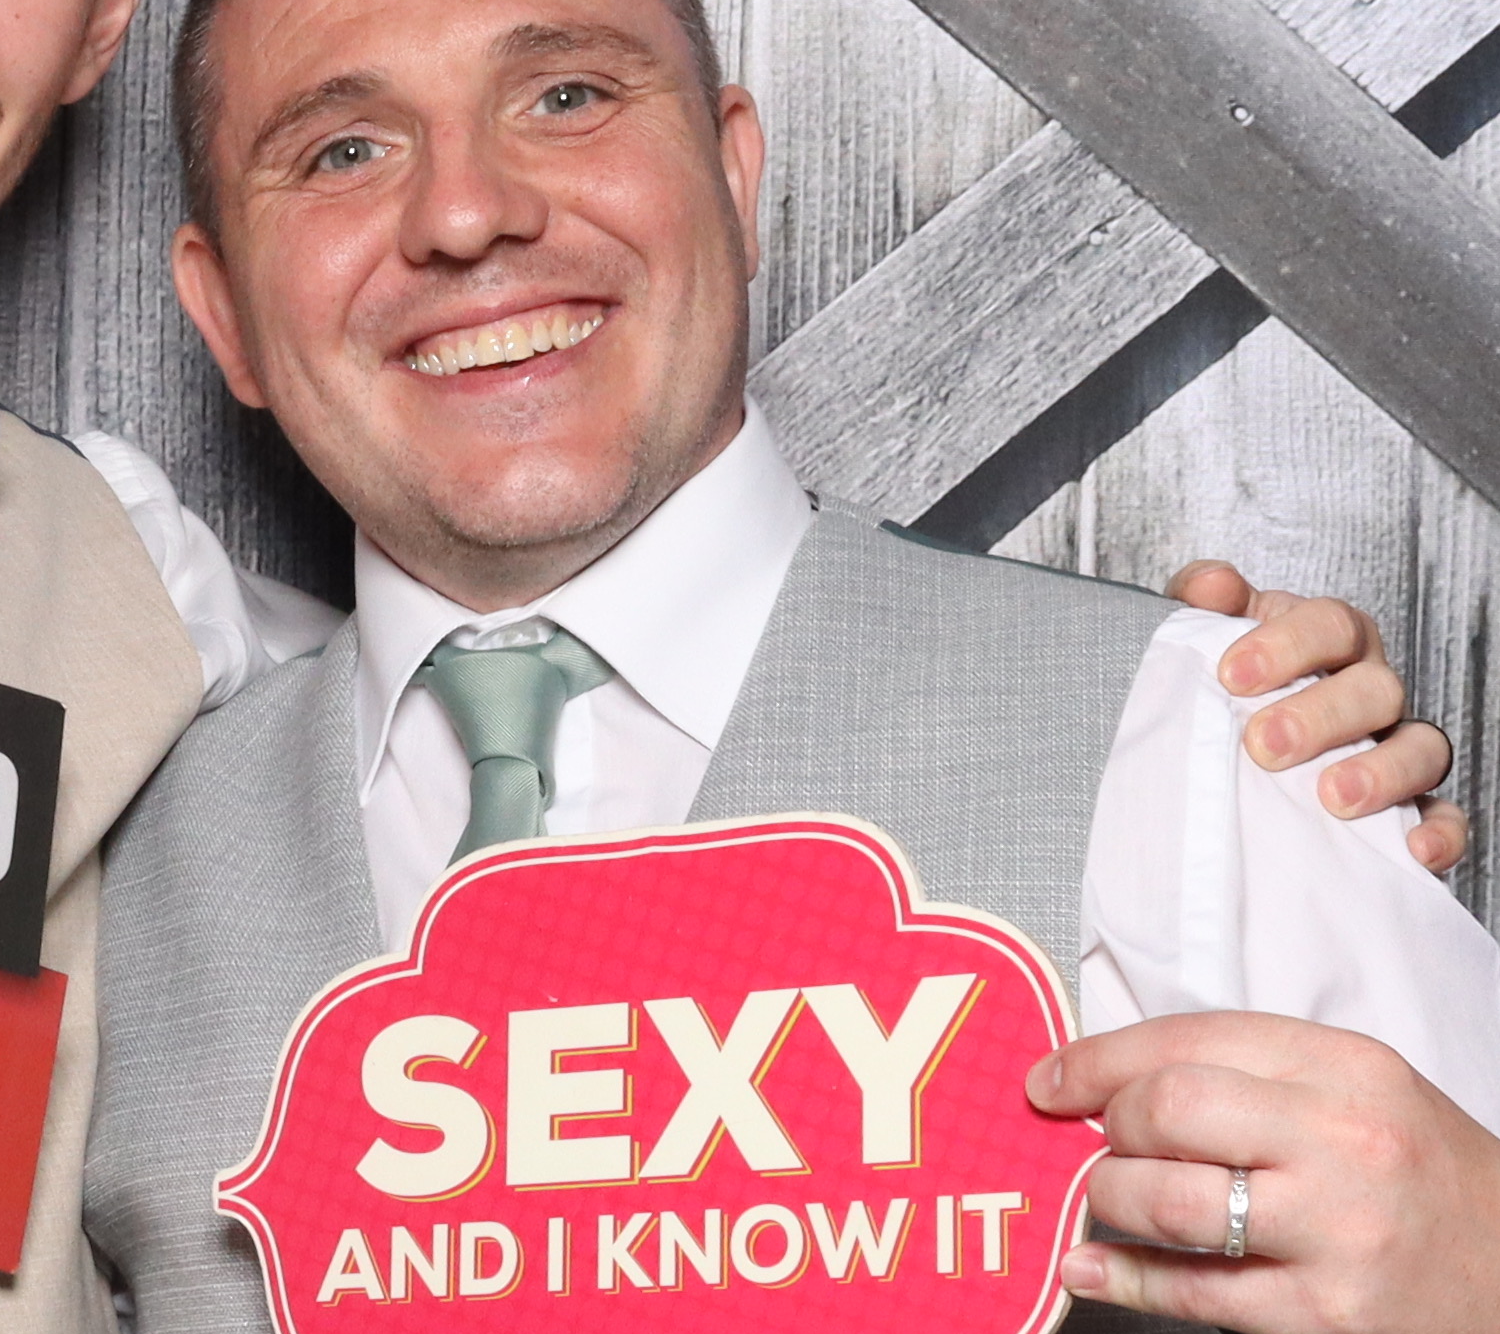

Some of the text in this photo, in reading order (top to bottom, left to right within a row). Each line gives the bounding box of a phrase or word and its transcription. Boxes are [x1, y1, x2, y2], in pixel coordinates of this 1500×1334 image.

[355, 973, 986, 1202] SEXY
[316, 1191, 1029, 1306] AND I KNOW IT
